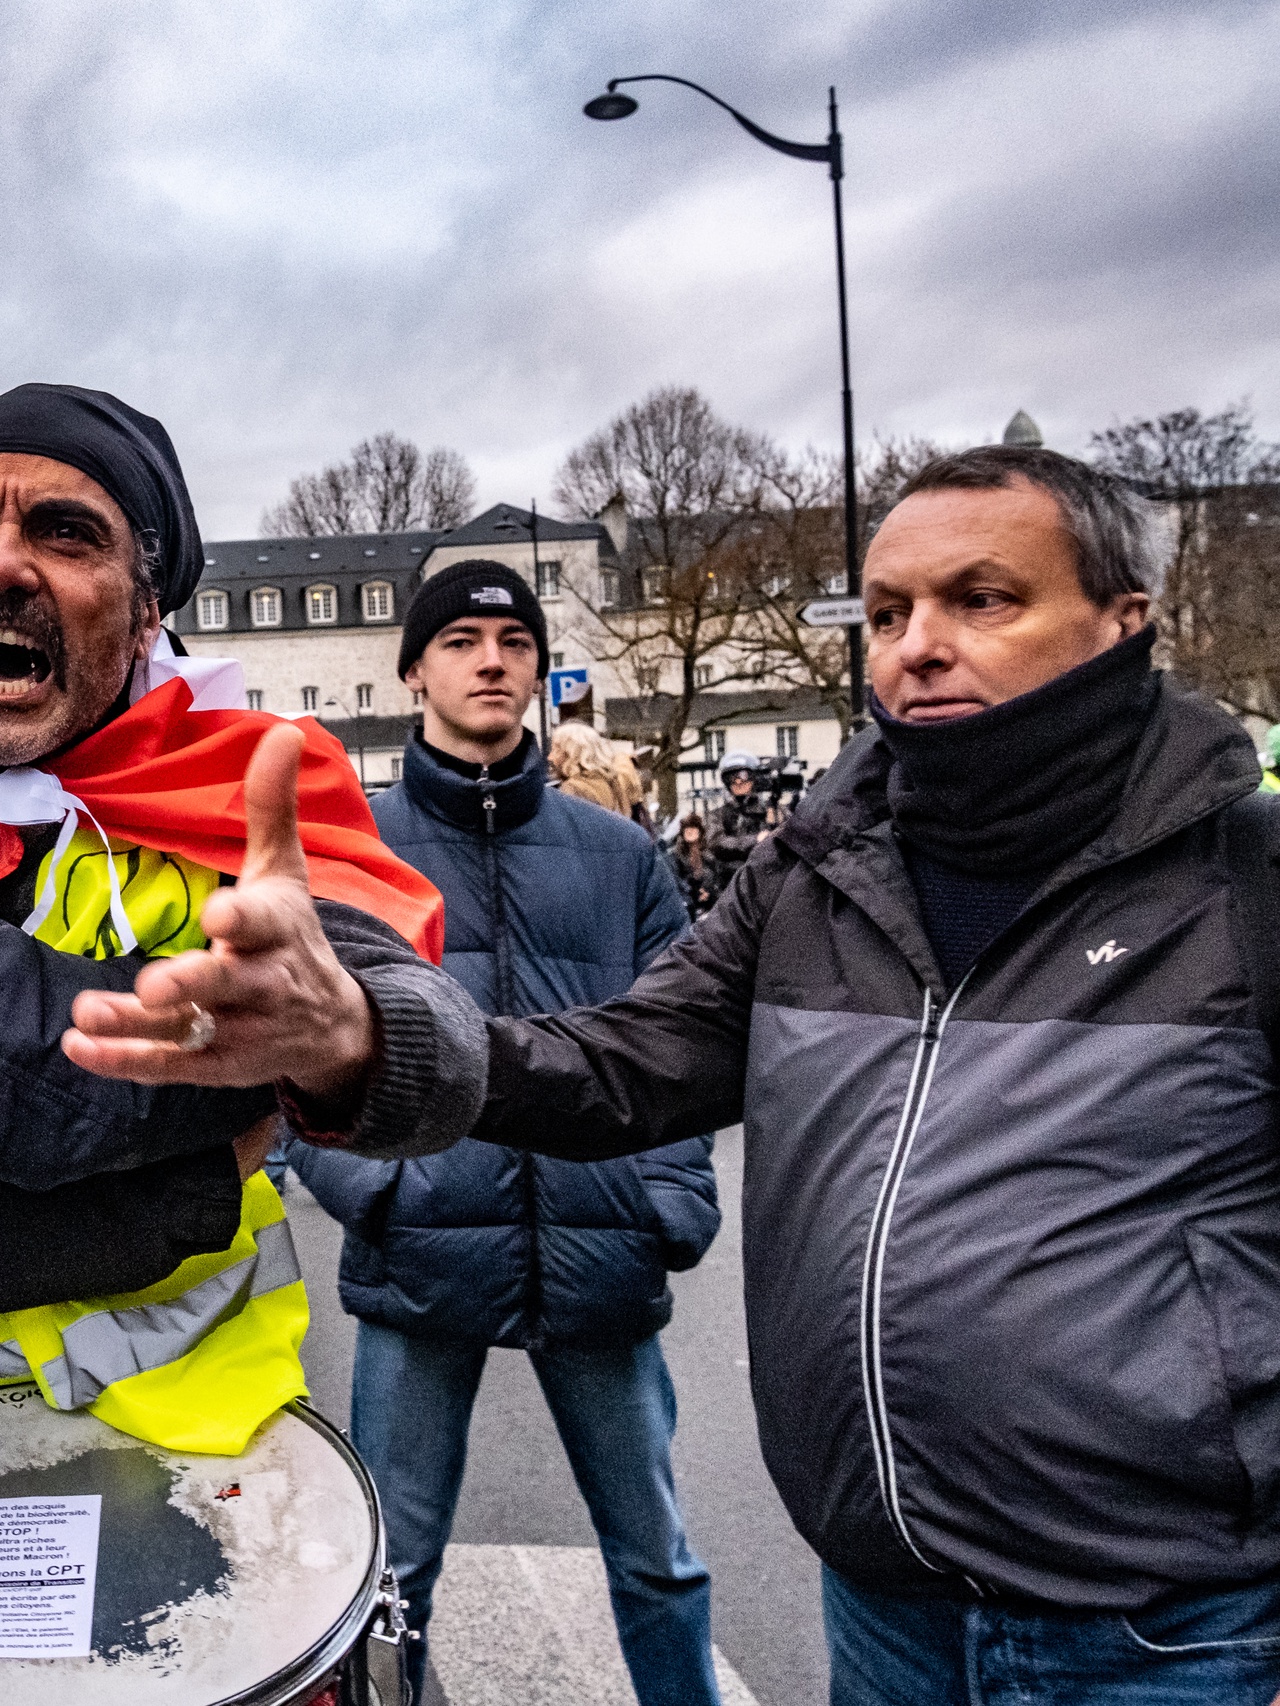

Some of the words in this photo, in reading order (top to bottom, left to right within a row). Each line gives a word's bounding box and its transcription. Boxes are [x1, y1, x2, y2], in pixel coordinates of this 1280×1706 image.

[31, 1503, 66, 1511] acquis
[16, 1511, 25, 1519] la
[23, 1536, 56, 1544] riches
[36, 1544, 43, 1552] à
[23, 1553, 64, 1561] Macron
[47, 1565, 85, 1576] CPT
[11, 1602, 53, 1610] citoyens.
